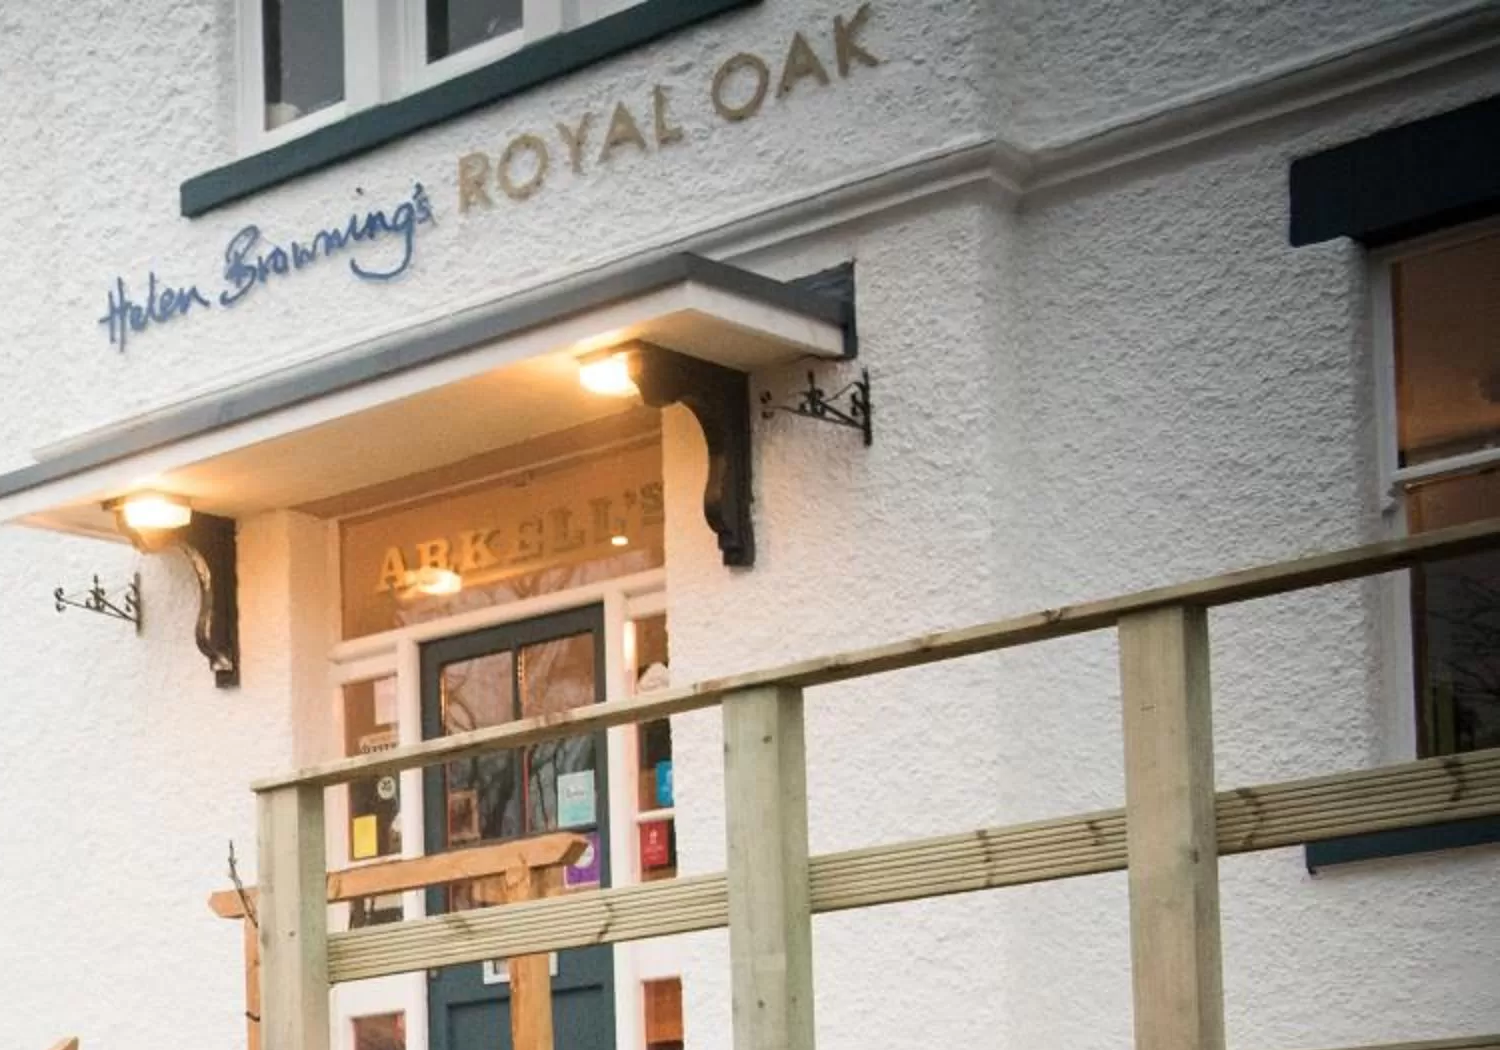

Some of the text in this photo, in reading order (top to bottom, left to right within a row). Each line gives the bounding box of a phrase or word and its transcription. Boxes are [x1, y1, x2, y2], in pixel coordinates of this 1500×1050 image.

[98, 3, 880, 353] Helen Browning's ROYAL OAK
[377, 481, 664, 596] ARKELL'S
